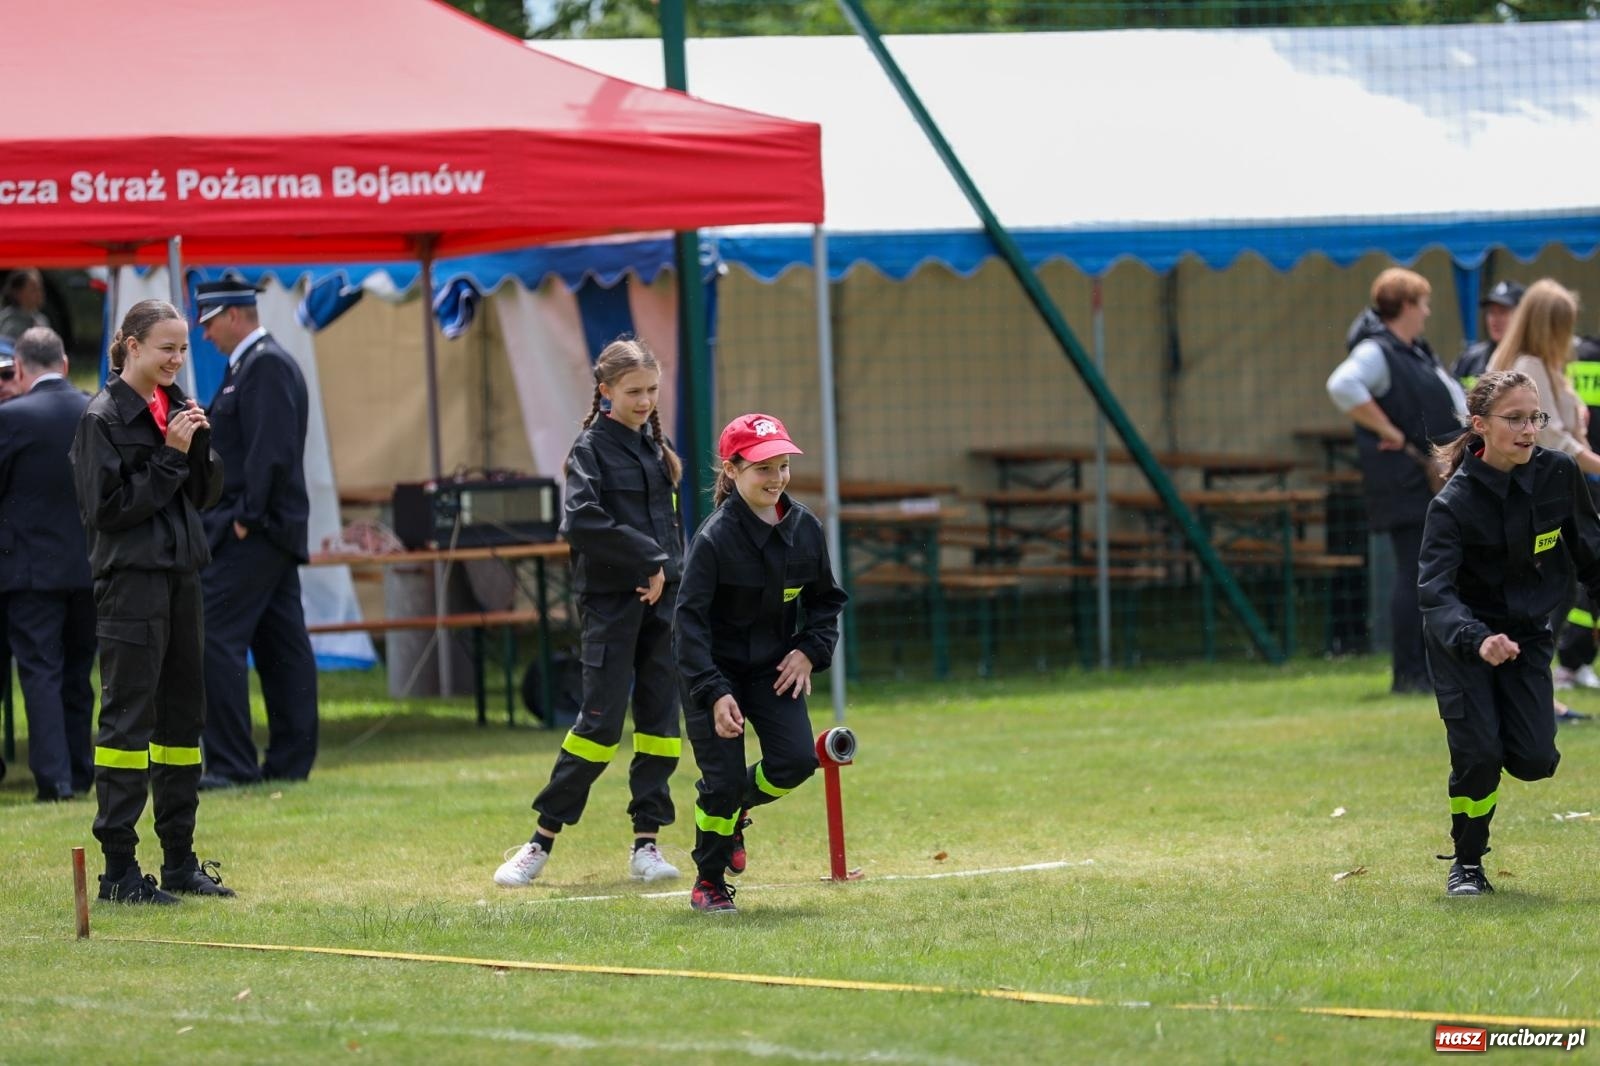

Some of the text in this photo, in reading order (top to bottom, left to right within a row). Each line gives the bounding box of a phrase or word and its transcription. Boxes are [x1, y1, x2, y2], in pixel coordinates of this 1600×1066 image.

[0, 163, 485, 204] cza Straż Pożarna Bojanów
